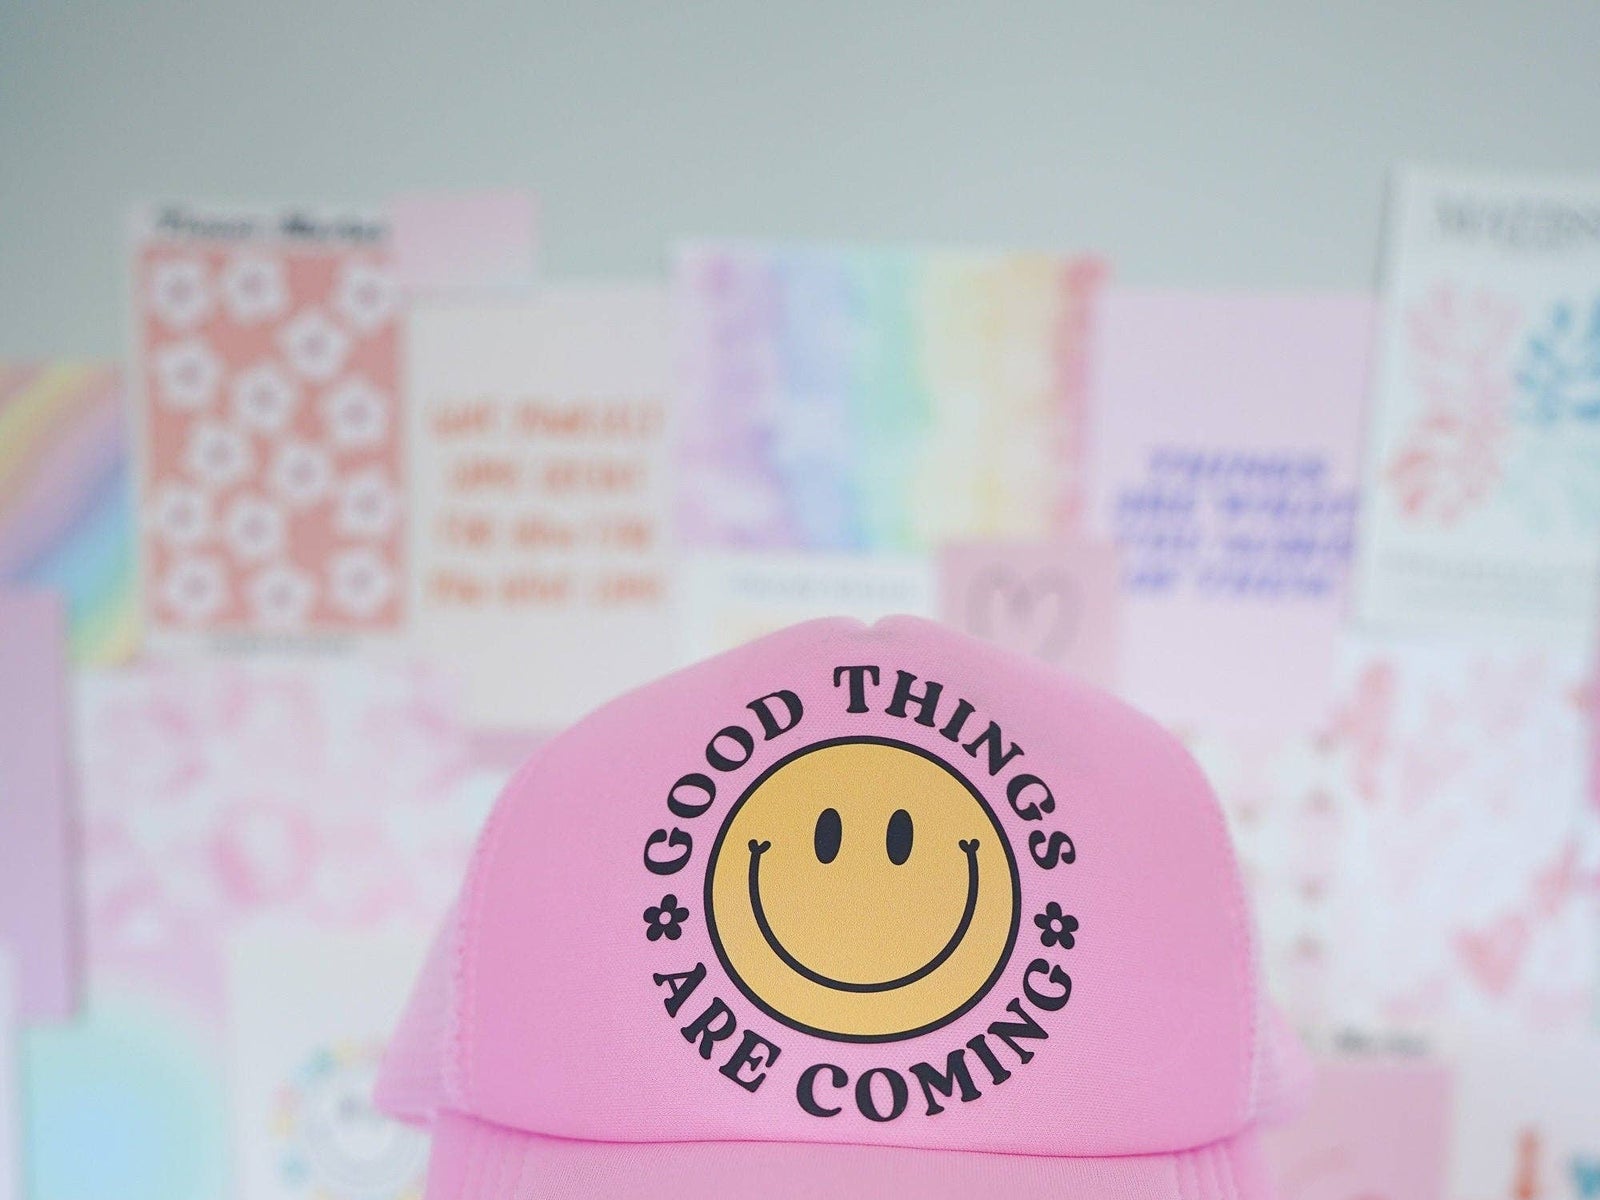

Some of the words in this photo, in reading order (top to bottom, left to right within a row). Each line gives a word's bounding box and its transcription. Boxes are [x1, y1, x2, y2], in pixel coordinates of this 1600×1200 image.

[643, 689, 804, 875] GOOD
[833, 665, 1076, 870] THINGS
[652, 961, 782, 1093] ARE
[796, 958, 1072, 1123] COMING
